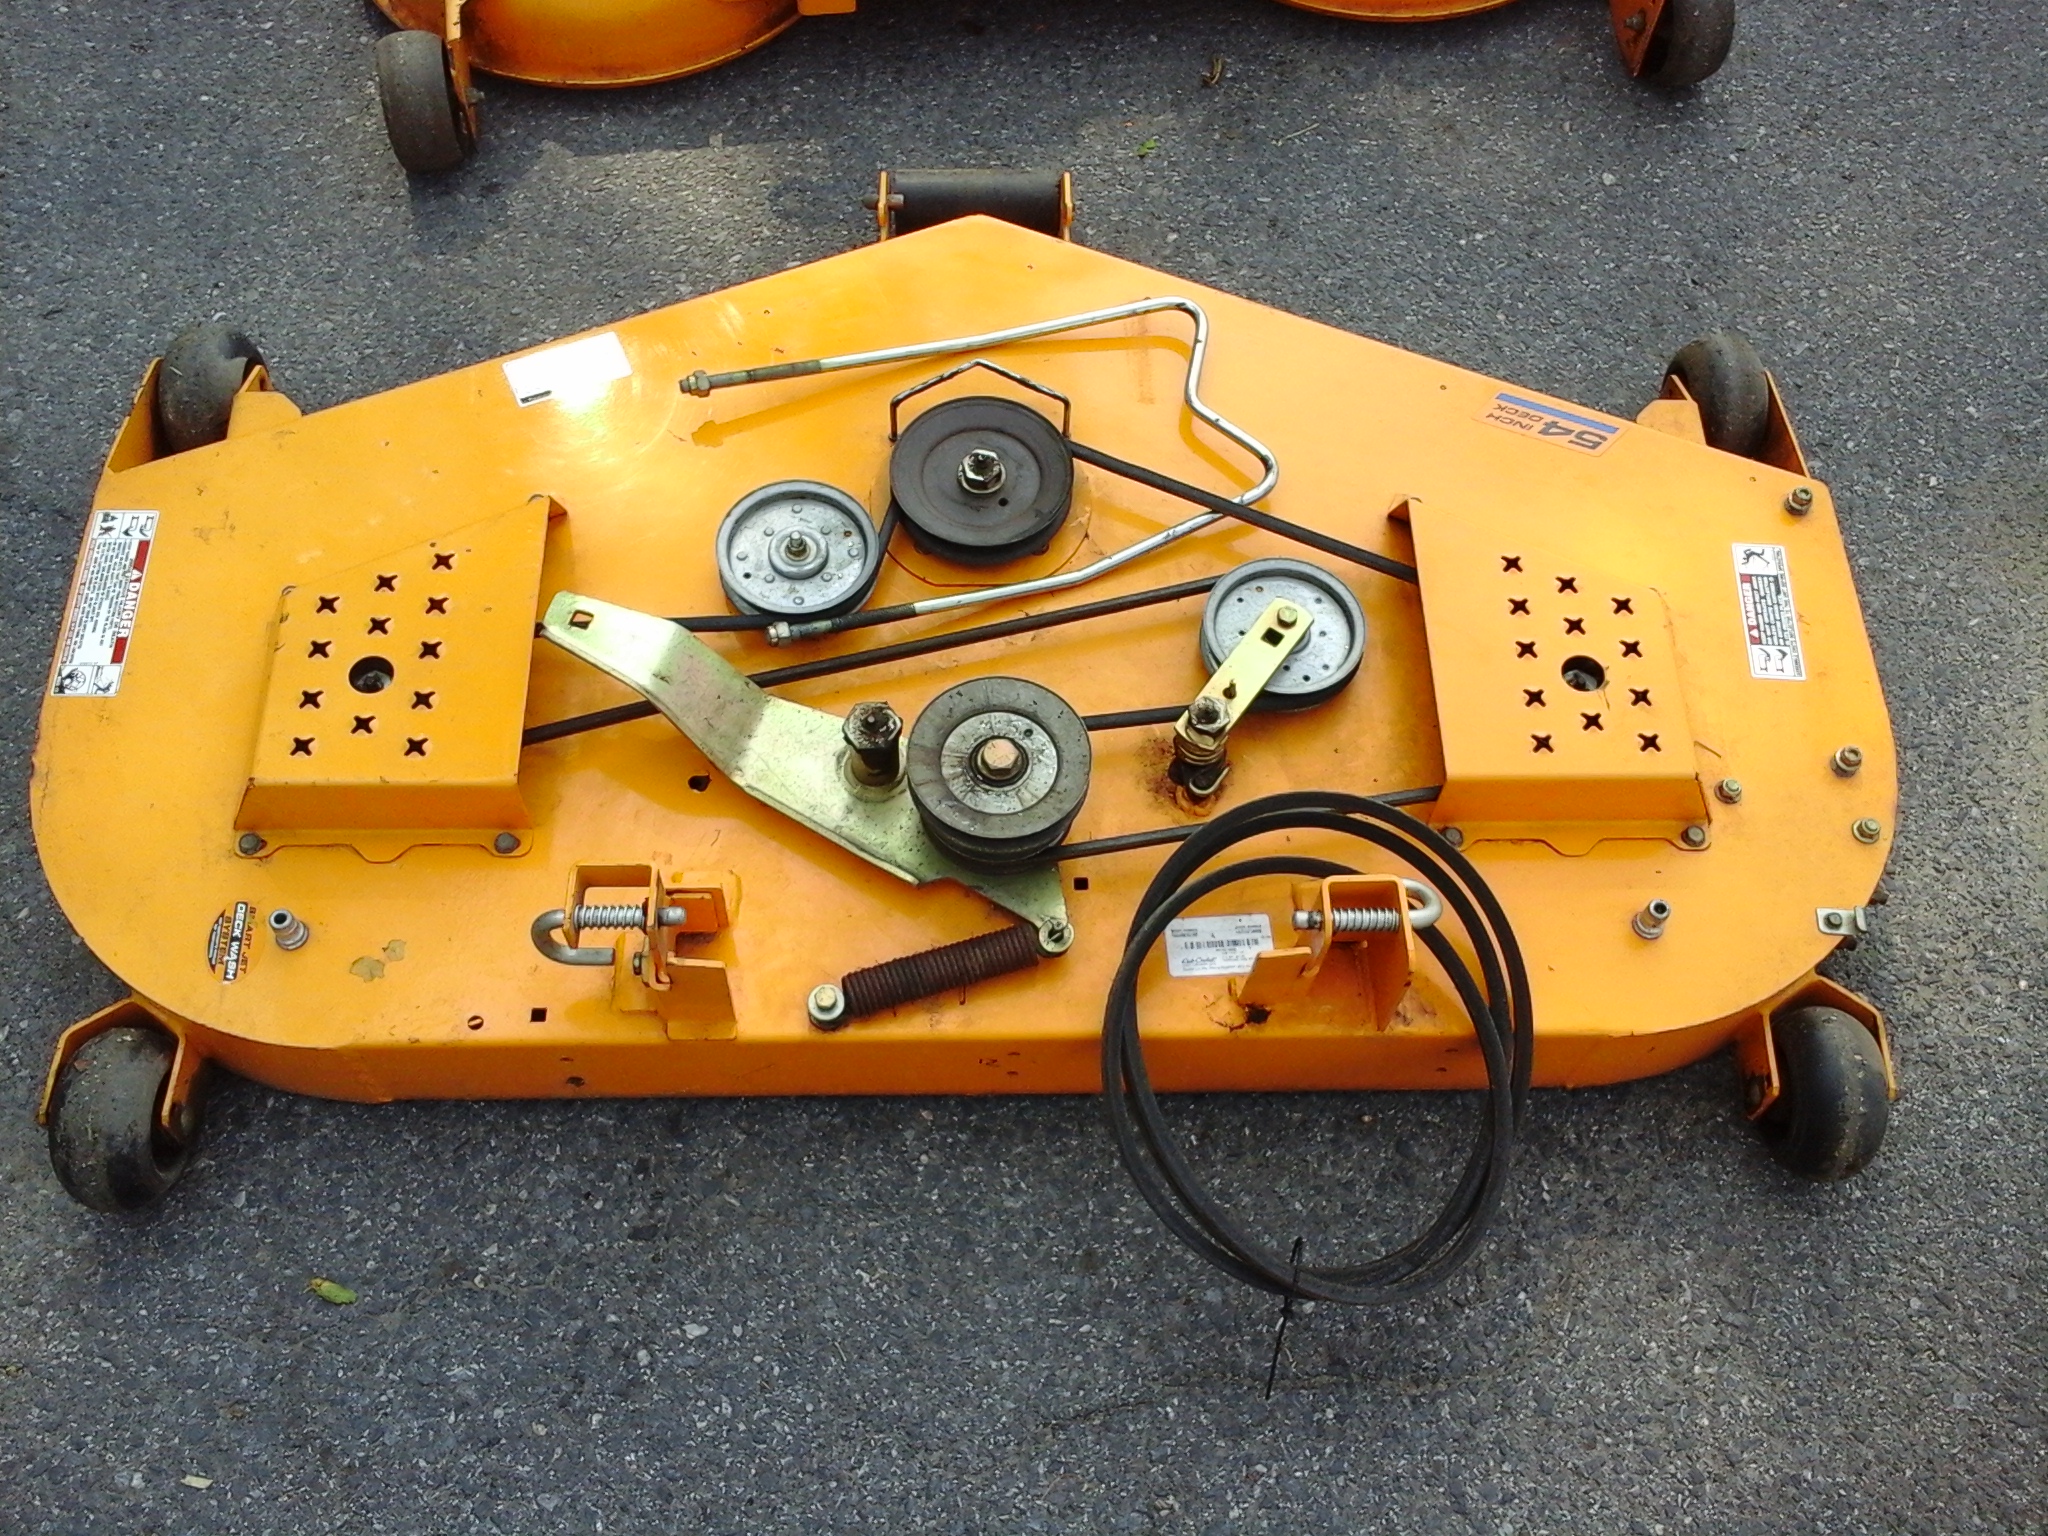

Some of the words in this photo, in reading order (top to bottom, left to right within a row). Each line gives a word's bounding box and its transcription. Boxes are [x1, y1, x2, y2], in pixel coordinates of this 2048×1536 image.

[1486, 413, 1534, 431] INCH
[1493, 404, 1544, 422] DECK
[1538, 420, 1608, 450] 54
[117, 582, 141, 638] DANGER
[1741, 582, 1758, 626] DANGER
[232, 903, 247, 938] DECK
[225, 941, 240, 979] WASH
